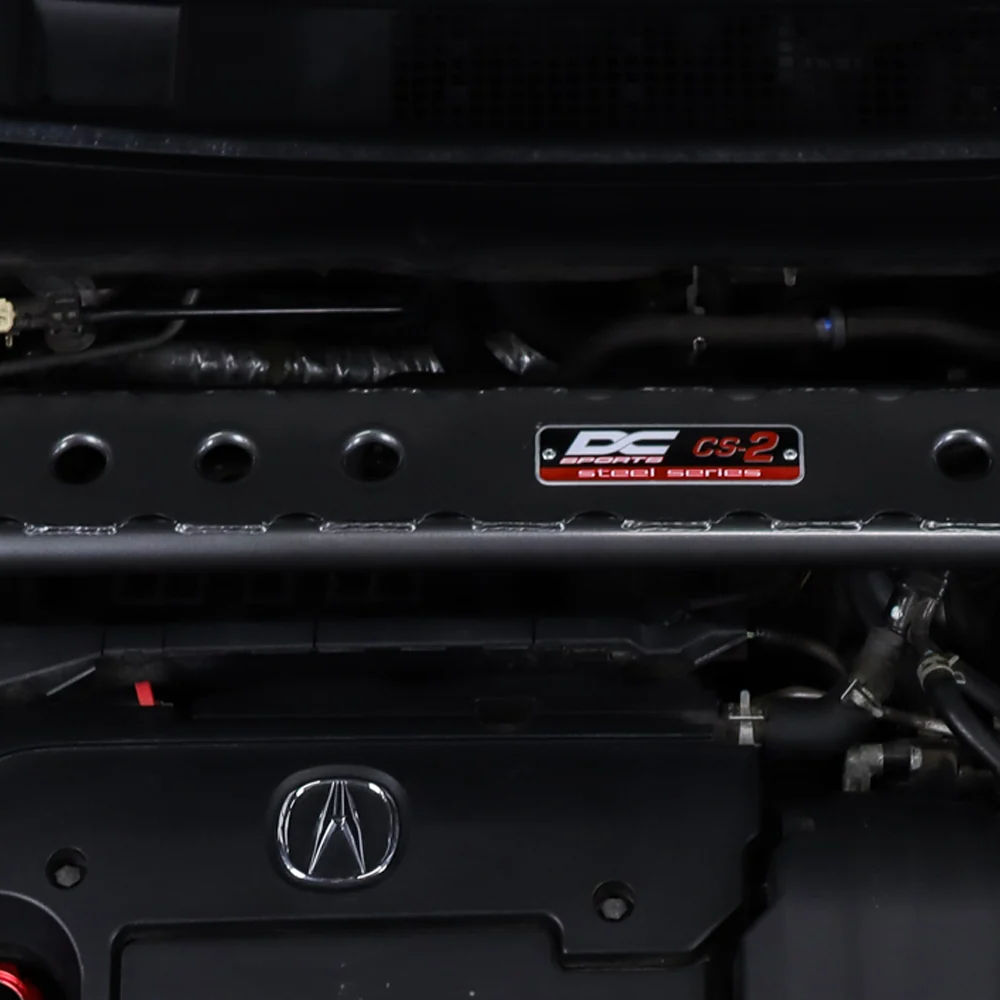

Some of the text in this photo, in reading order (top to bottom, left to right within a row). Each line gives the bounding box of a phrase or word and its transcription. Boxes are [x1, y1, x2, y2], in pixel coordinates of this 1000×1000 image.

[564, 430, 680, 455] DC
[692, 431, 779, 463] CS-2
[559, 456, 664, 465] SPORTS
[578, 467, 761, 478] steel series
